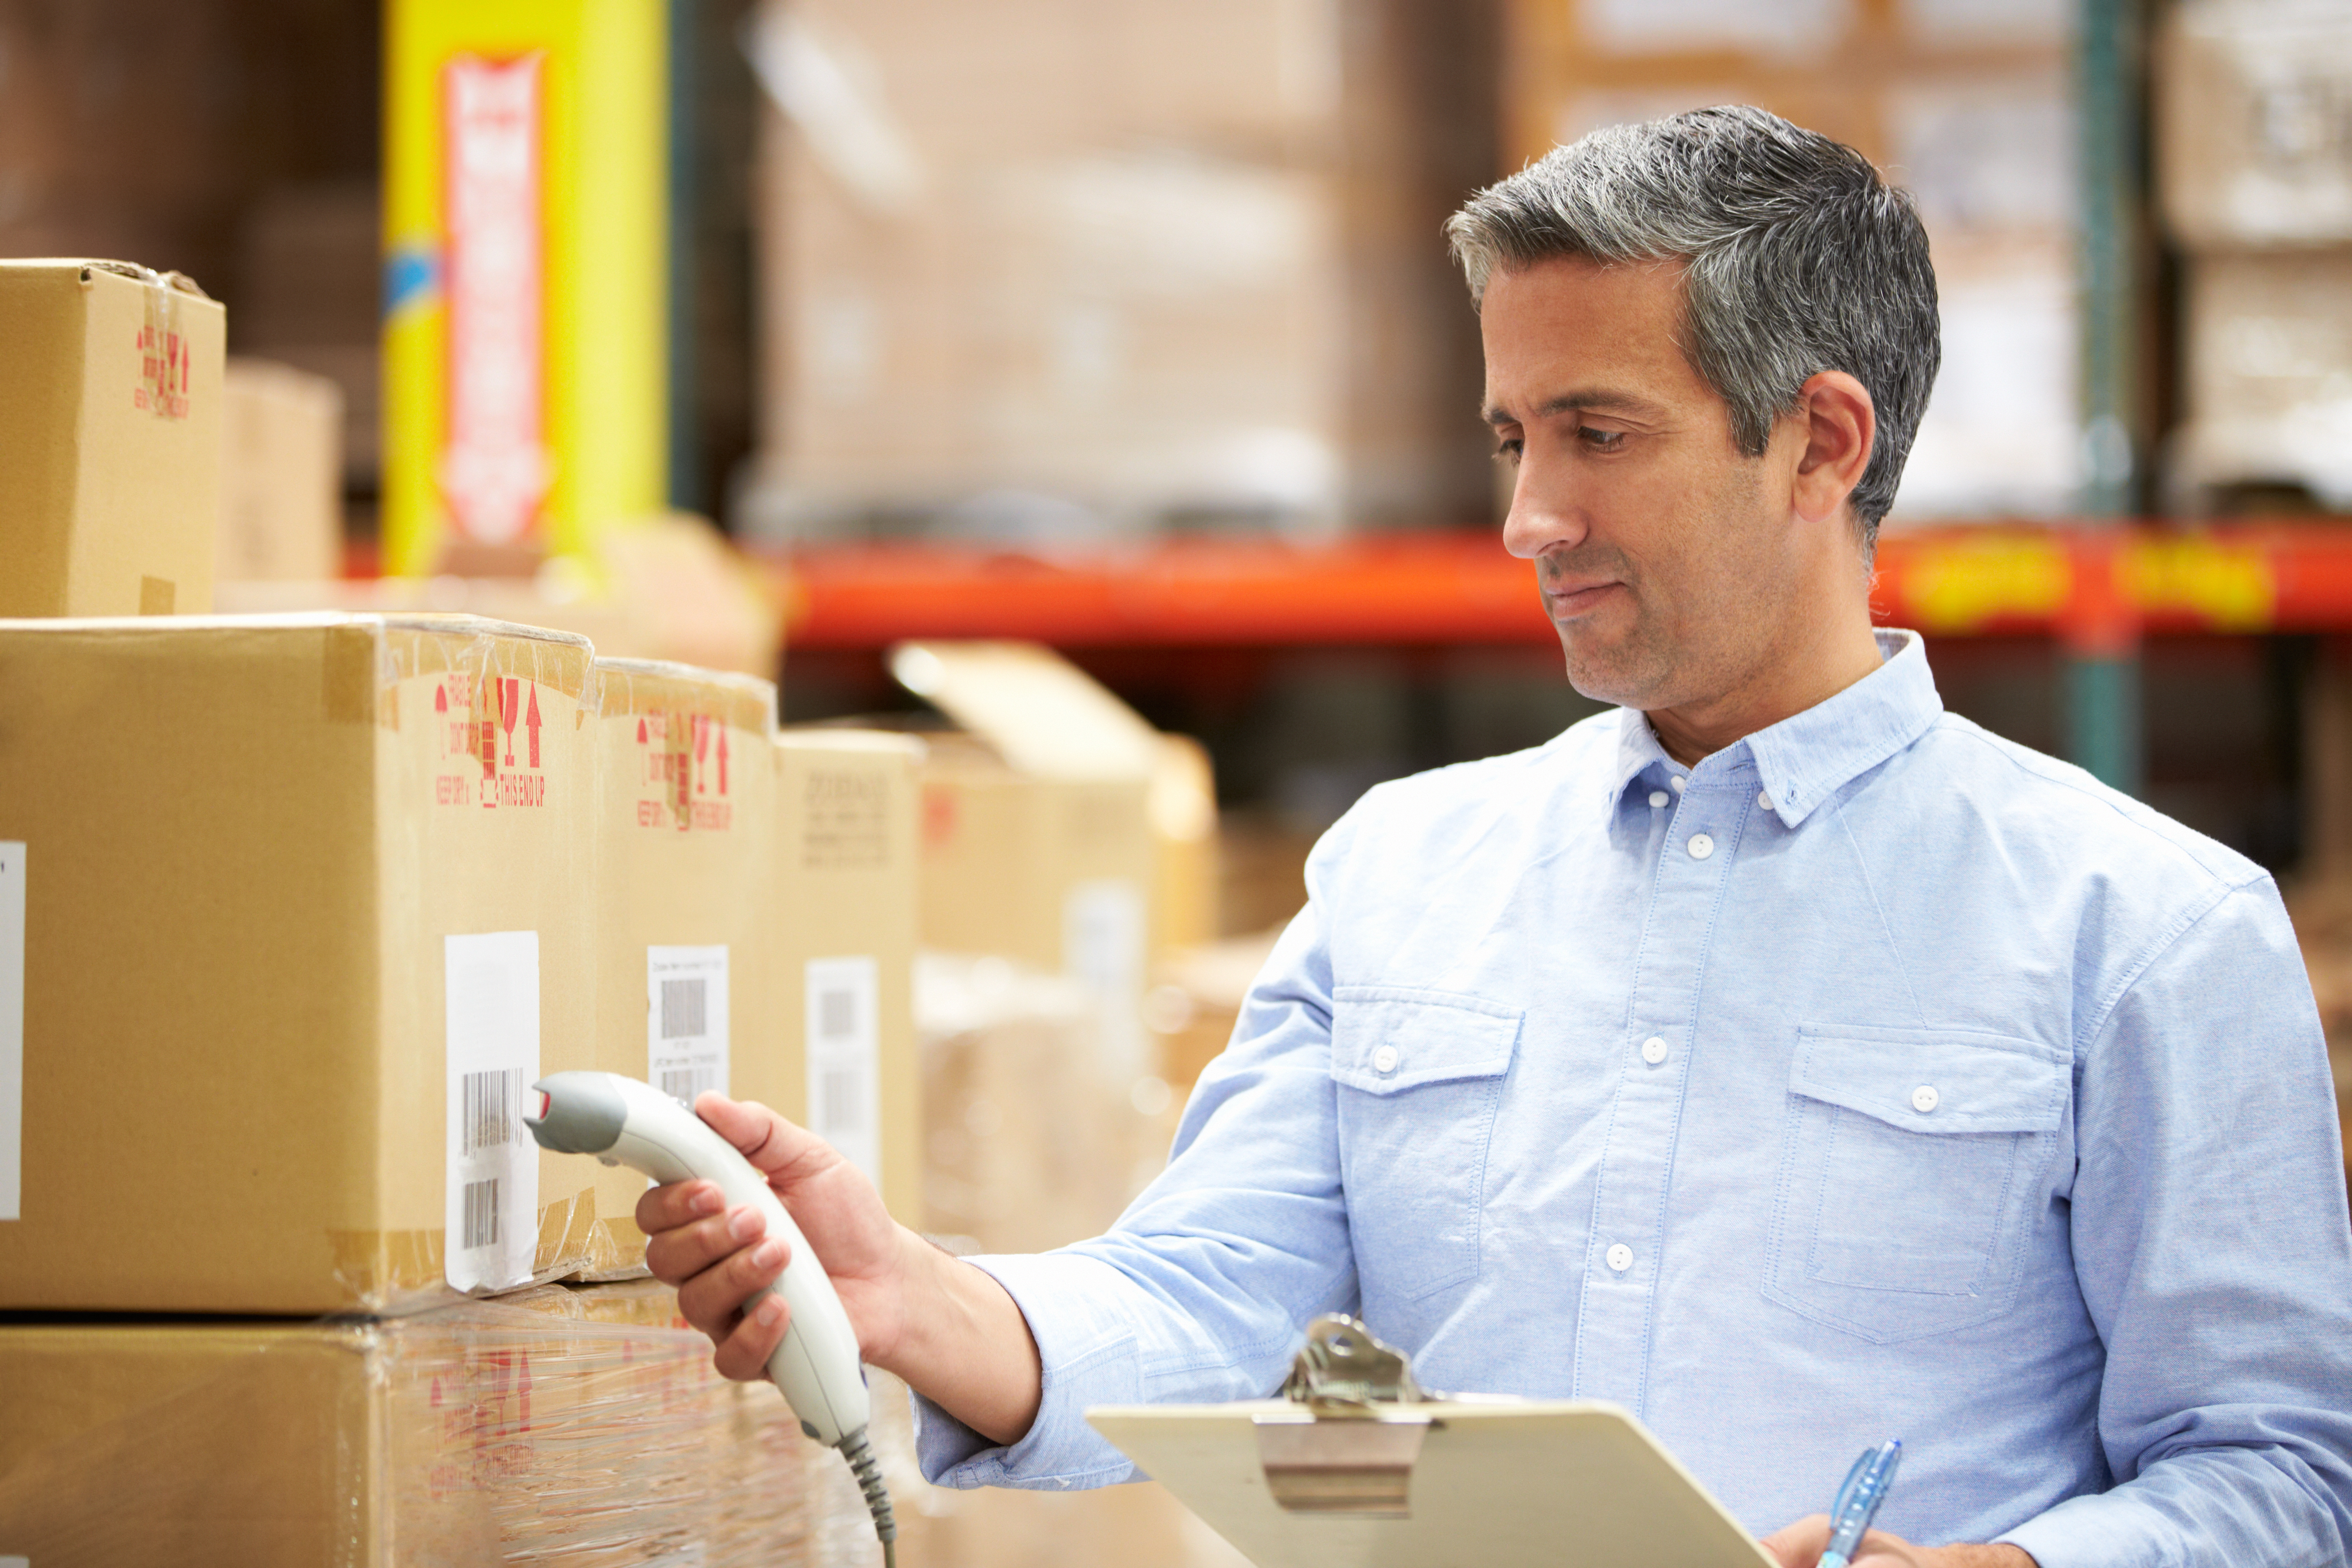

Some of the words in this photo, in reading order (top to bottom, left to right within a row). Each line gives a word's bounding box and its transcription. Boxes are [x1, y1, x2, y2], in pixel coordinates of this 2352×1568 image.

[500, 774, 517, 806] THIS
[519, 774, 533, 807] END
[535, 775, 544, 807] UP
